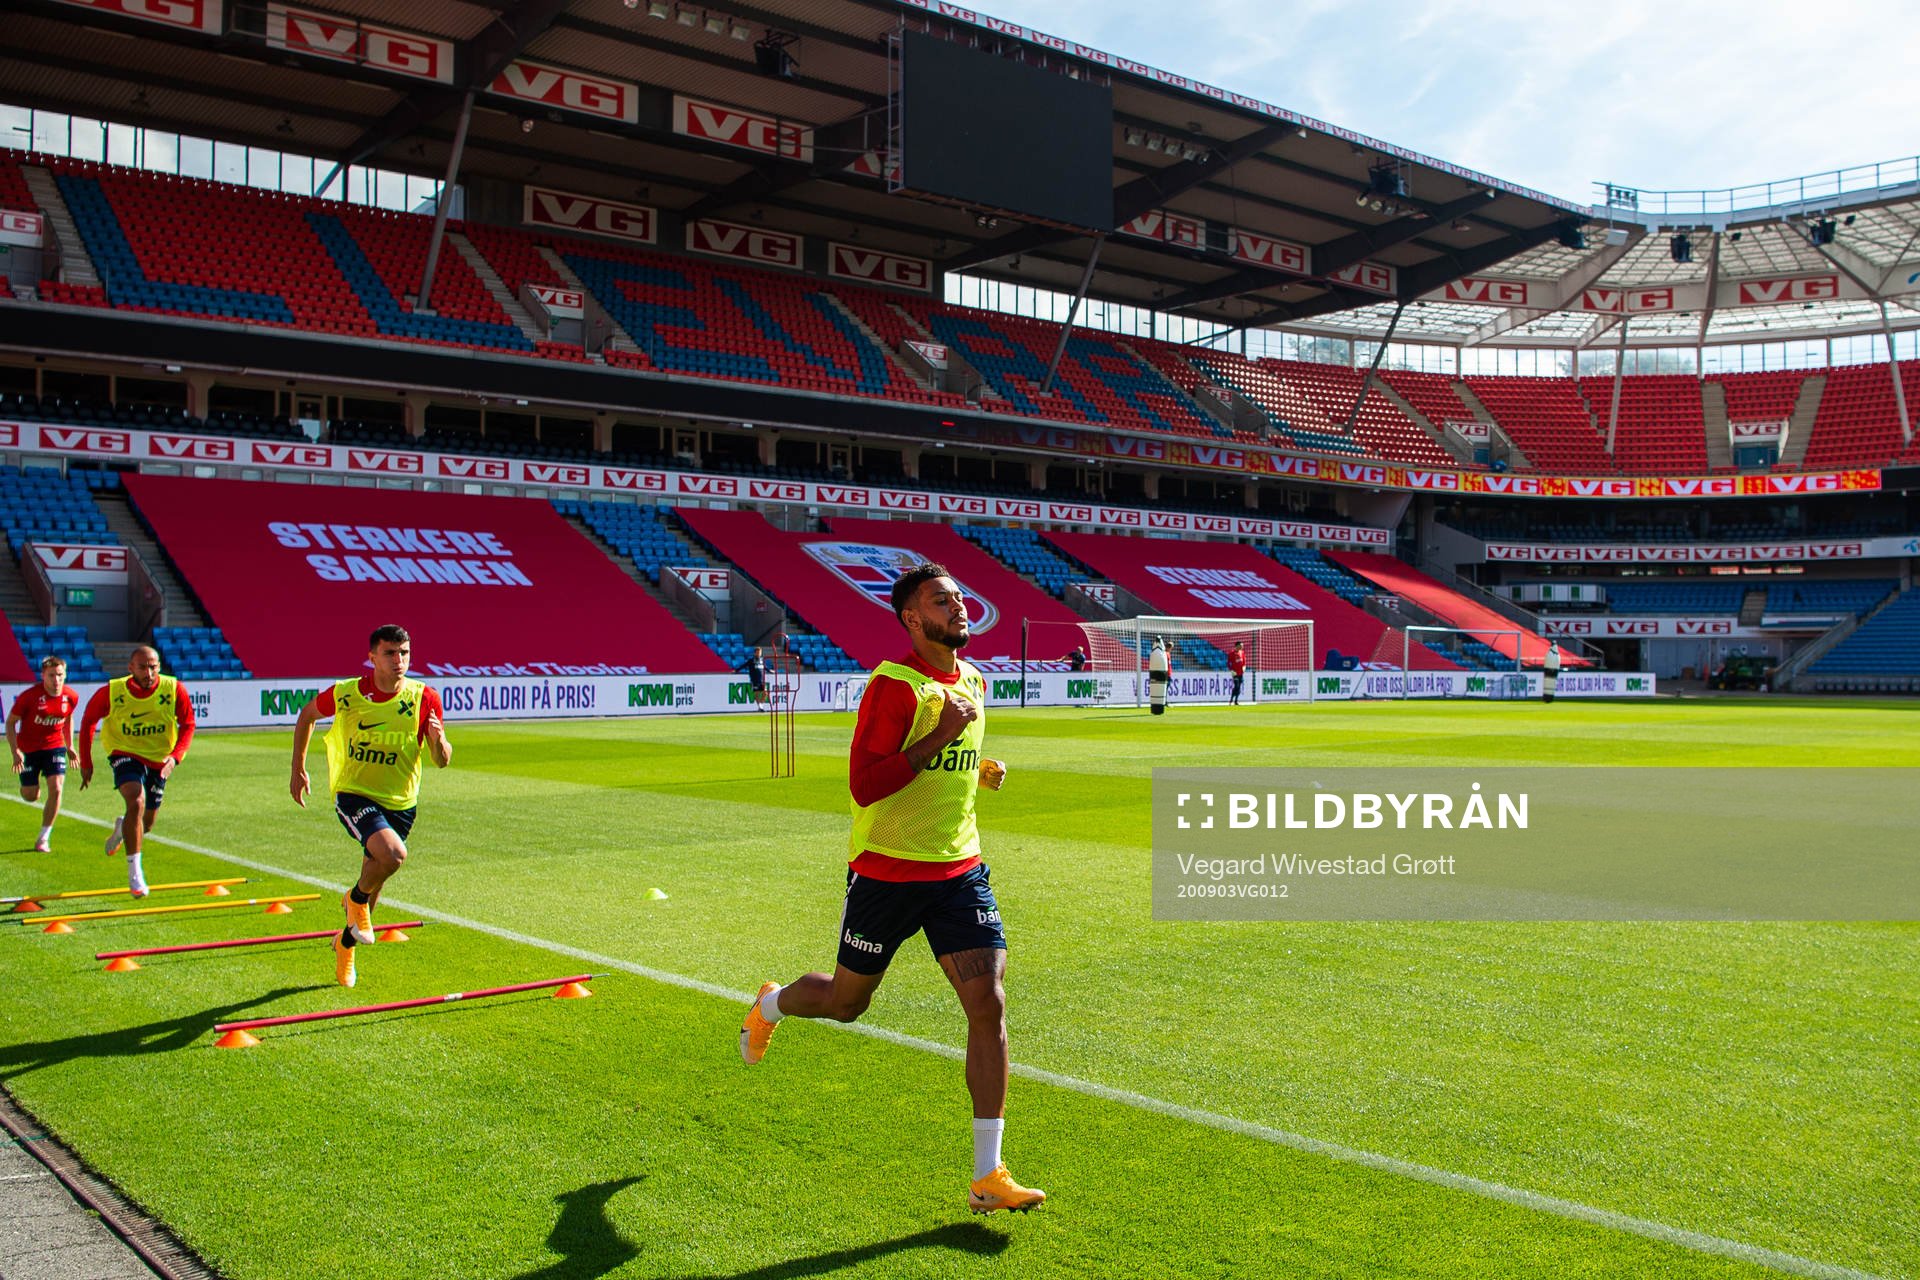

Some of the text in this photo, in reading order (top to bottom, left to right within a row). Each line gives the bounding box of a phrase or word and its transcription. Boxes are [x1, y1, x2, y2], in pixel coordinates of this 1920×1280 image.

[293, 20, 430, 75] VG
[942, 4, 974, 22] VG
[990, 18, 1021, 37] VG
[1034, 33, 1065, 50] VG
[1078, 48, 1106, 63] VG
[1119, 59, 1147, 76] VG
[1158, 72, 1185, 87] VG
[1196, 83, 1223, 98] VG
[1234, 95, 1258, 109] VG
[1268, 106, 1292, 120] VG
[1302, 116, 1325, 130] VG
[1335, 127, 1357, 140] VG
[1365, 137, 1386, 150] VG
[503, 62, 796, 155] VG VG
[0, 213, 36, 233] G
[537, 192, 924, 286] VG VG VG
[1130, 214, 1197, 244] VG
[1239, 235, 1300, 269] VG
[531, 288, 579, 306] VG
[1450, 278, 1837, 309] VG VG VG
[1451, 425, 1486, 435] VG
[1737, 424, 1781, 435] VG
[1017, 427, 1838, 495] VG VG VG VG VG VG VG VG VG VG
[43, 429, 1387, 543] VG VG VG VG VG VG VG VG VG VG VG VG VG VG VG VG VG VG VG VG VG
[268, 522, 513, 556] STERKERE
[35, 549, 126, 569] VG
[1490, 545, 1861, 561] VG VG VG VG VG VG VG
[306, 554, 534, 586] SAMMEN
[1547, 622, 1730, 633] VG VG VG
[427, 662, 535, 677] Norsk
[628, 683, 695, 706] KIWI mini
[819, 681, 831, 702] VI
[1027, 680, 1041, 689] mini
[1067, 679, 1097, 698] KIWI
[1182, 678, 1206, 696] ALDRI
[1209, 674, 1221, 696] PÅ
[1262, 678, 1287, 695] KIWI
[1317, 677, 1340, 694] KIWI
[443, 680, 596, 711] OSS ALDRI PÅ PRIS!
[676, 695, 693, 708] pris
[1027, 690, 1040, 700] pris
